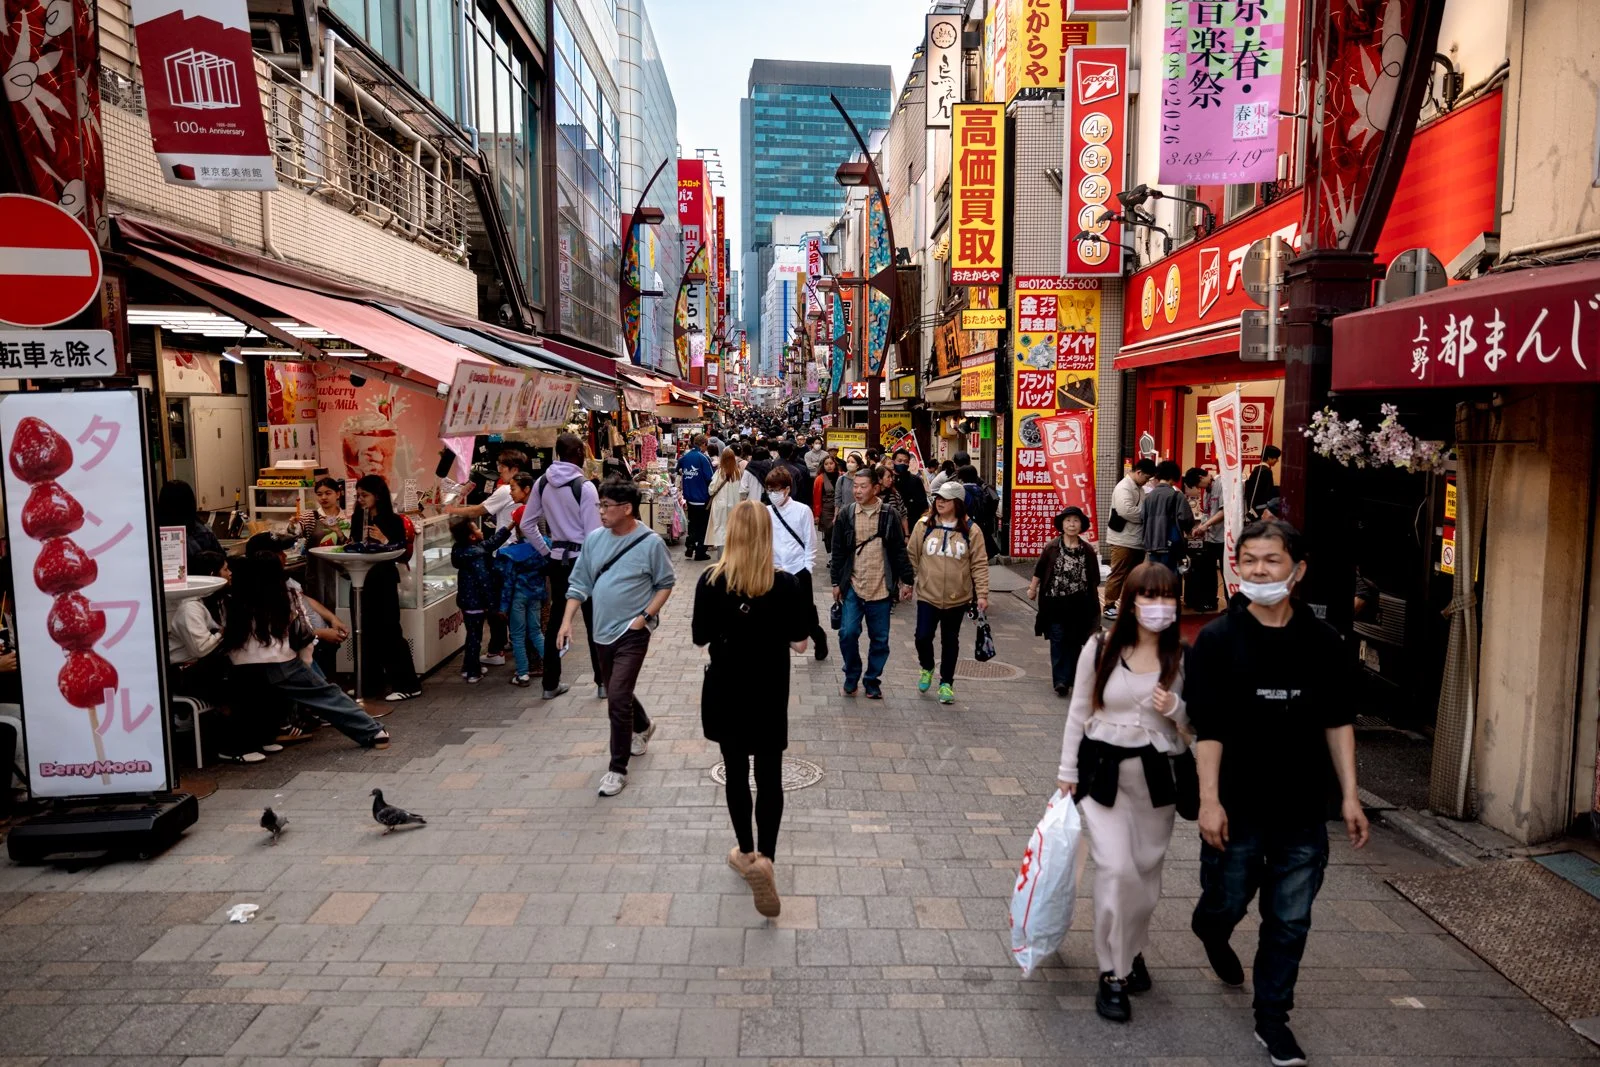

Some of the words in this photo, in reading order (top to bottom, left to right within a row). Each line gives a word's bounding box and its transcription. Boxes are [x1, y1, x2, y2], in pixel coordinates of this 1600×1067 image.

[1168, 42, 1182, 95] TOKYO
[1083, 74, 1116, 85] ADORES
[173, 121, 207, 134] 100th
[208, 127, 245, 137] Anniversary
[1085, 120, 1107, 138] 4F
[1163, 99, 1182, 145] 2026
[1084, 151, 1107, 168] 3F
[200, 166, 263, 178] 東京都美術館
[958, 108, 998, 264] 高価買取
[1084, 180, 1106, 198] 2F
[1084, 241, 1102, 258] B1
[952, 270, 1000, 281] おたからや
[1028, 279, 1098, 289] 0120-555-600
[1167, 277, 1179, 310] 4F
[1020, 296, 1038, 315] 金
[1039, 307, 1056, 316] チナ
[962, 315, 1005, 325] おたからや
[1019, 318, 1056, 332] 貴金属
[1059, 334, 1095, 354] ダイヤ
[1410, 315, 1430, 380] 上野
[0, 341, 107, 368] 転車を除く
[1019, 372, 1055, 390] ブランド
[334, 400, 359, 410] Milk
[1018, 390, 1054, 407] バッグ
[1018, 449, 1047, 468] 切手
[926, 537, 966, 560] GAP
[77, 414, 154, 735] タンフル
[39, 757, 153, 778] BerryMoon
